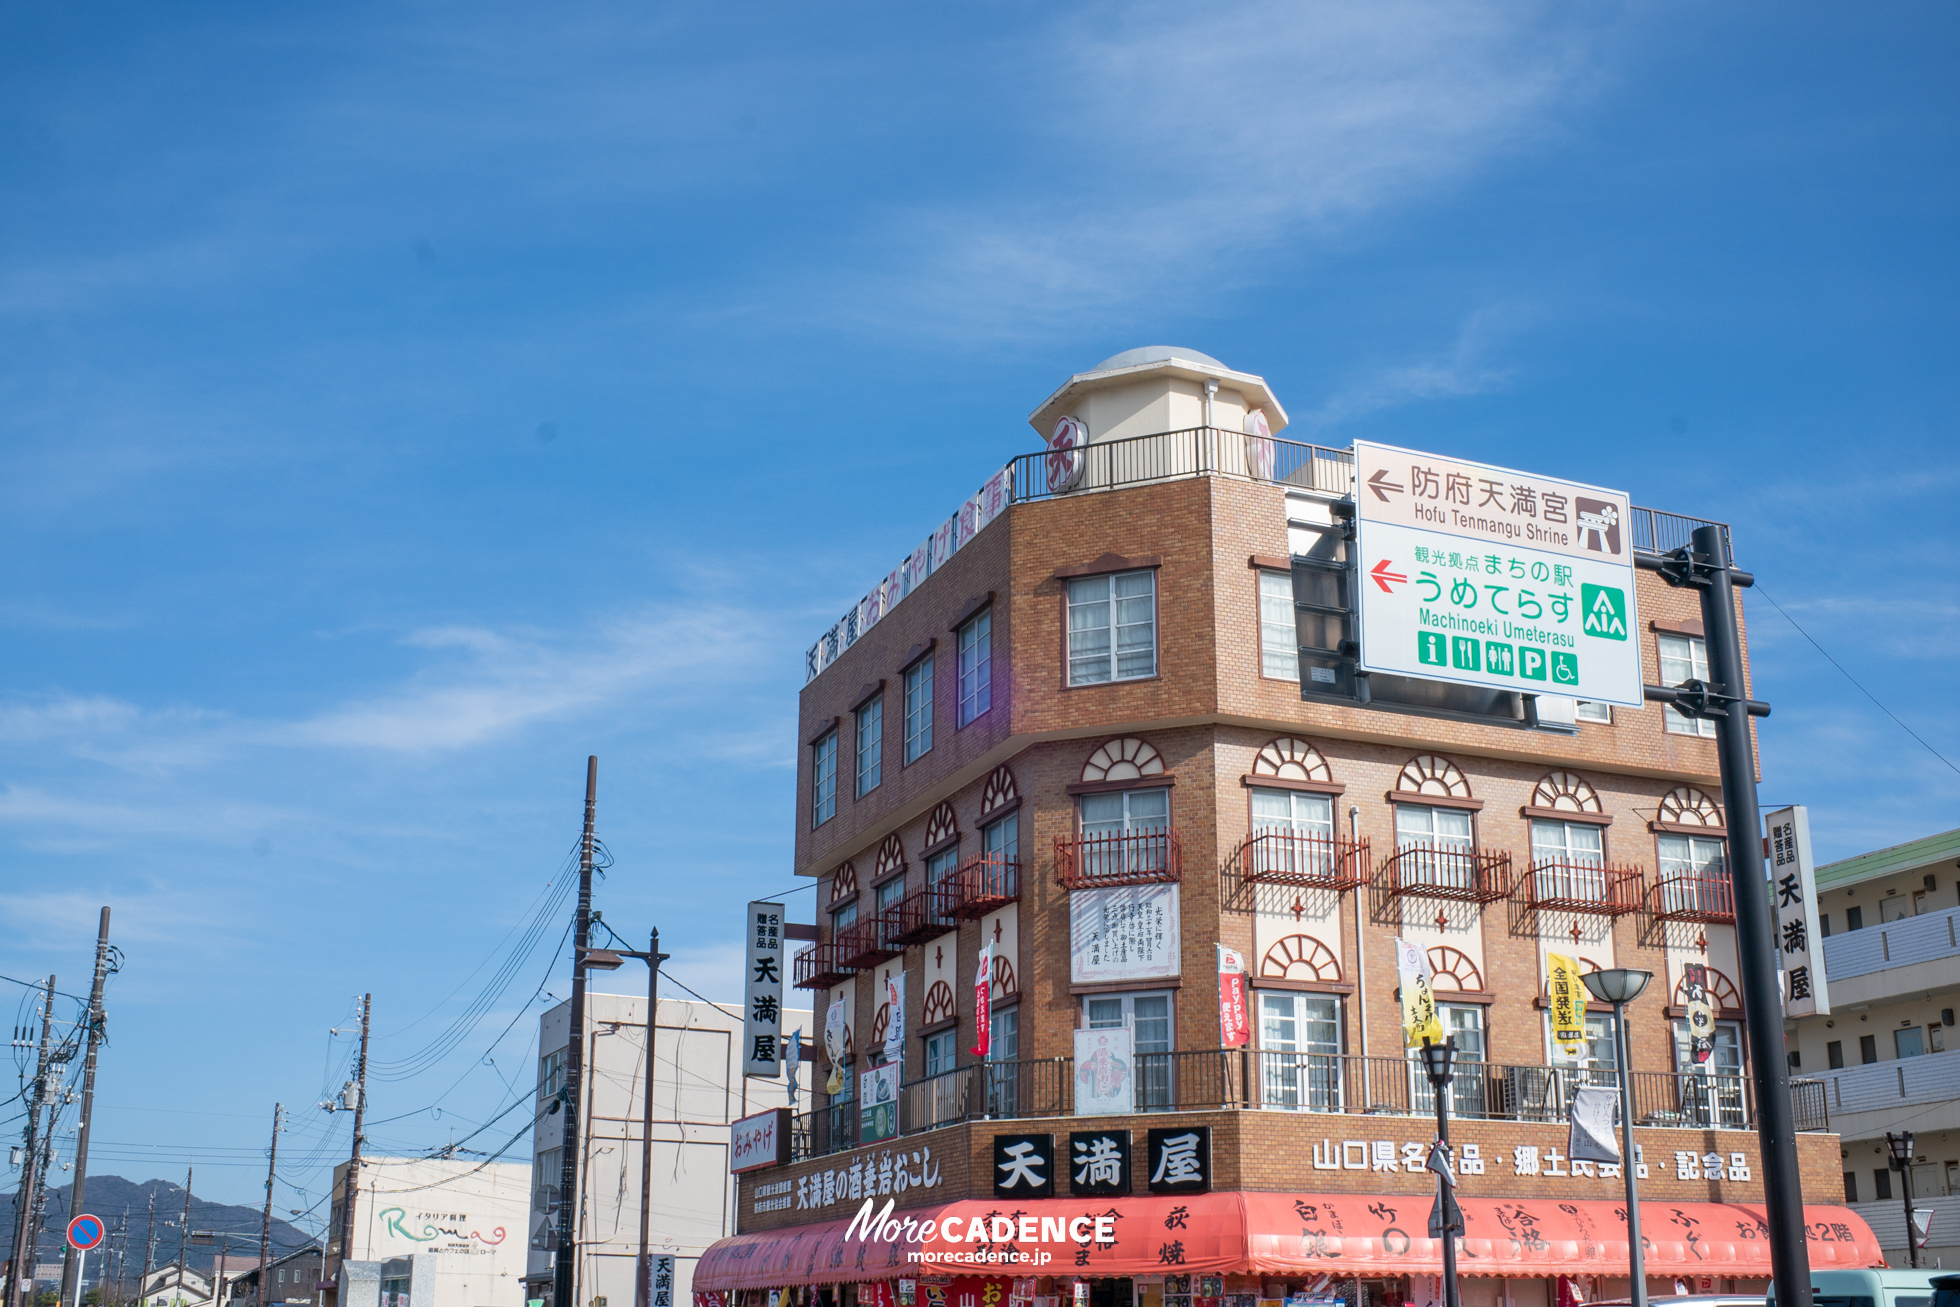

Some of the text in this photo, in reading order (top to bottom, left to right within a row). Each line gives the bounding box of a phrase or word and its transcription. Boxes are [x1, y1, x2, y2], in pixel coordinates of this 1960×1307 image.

[1411, 465, 1568, 524] 防府天満宮
[1414, 502, 1569, 546] Hofu Tenmangu Shrine
[1415, 571, 1574, 623] うめてらす
[1419, 607, 1575, 648] Machinoeki Umeterasu
[1772, 825, 1786, 867] 贈答品
[1782, 822, 1795, 864] 名産品
[756, 913, 767, 949] 贈答品
[768, 914, 779, 950] 名産品
[1091, 931, 1101, 965] 天満屋
[1778, 872, 1811, 1002] 天満屋
[751, 957, 779, 1063] 天満屋
[1222, 1002, 1236, 1042] 使えます
[1231, 977, 1243, 1030] PayPay
[735, 1121, 774, 1158] おみやげ
[998, 1132, 1203, 1189] 天満屋
[416, 1213, 468, 1222] イタリア料理
[1292, 1199, 1341, 1258] 白銀
[1322, 1202, 1347, 1240] かまぼこ
[1513, 1210, 1551, 1253] 合格
[654, 1256, 672, 1307] 天満屋
